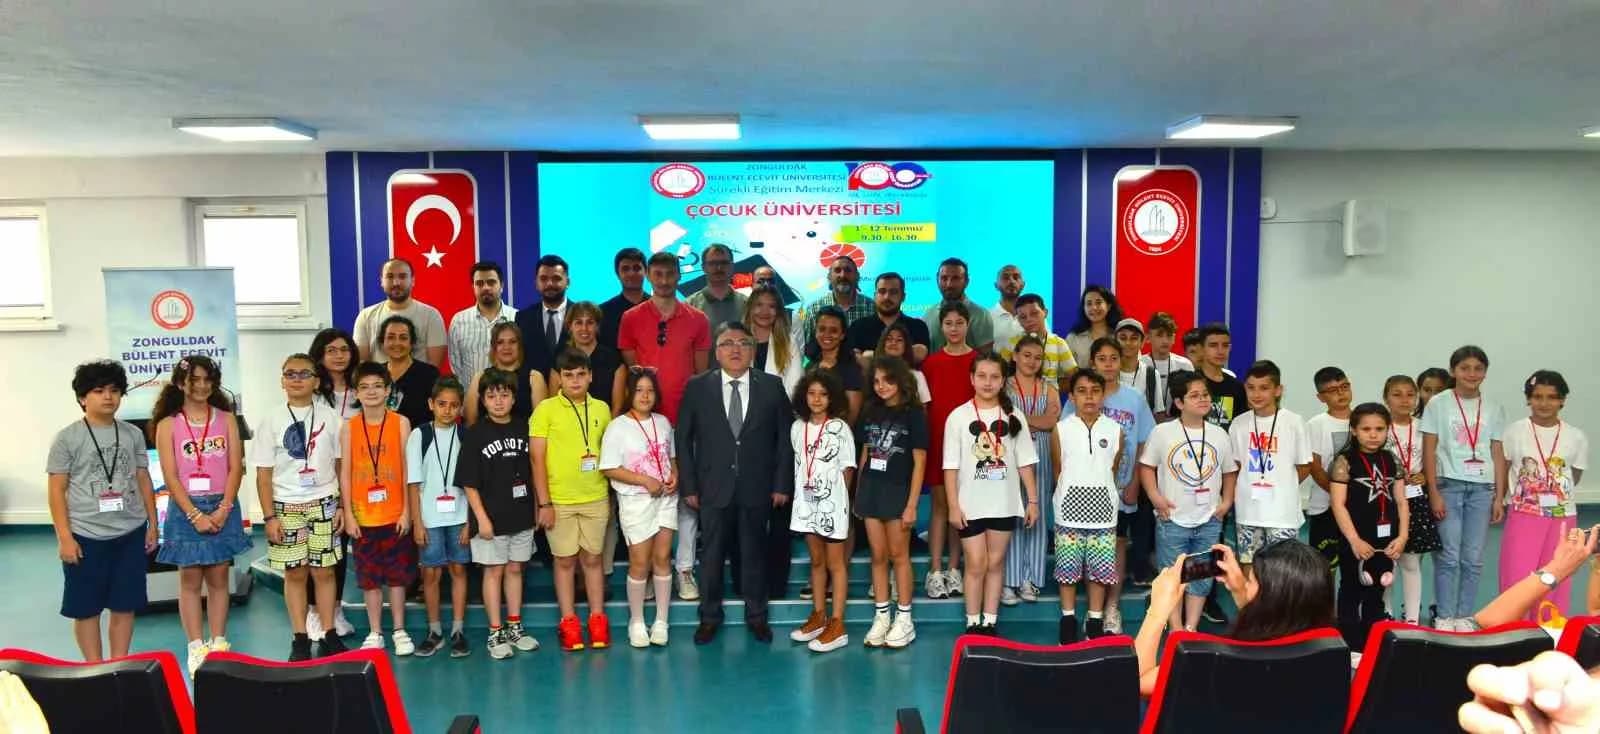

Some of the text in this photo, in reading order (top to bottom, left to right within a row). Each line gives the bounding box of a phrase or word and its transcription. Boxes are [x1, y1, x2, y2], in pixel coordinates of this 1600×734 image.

[709, 184, 844, 195] Sürekli Eğitim Merkezi
[685, 201, 901, 219] ÇOCUK ÜNİVERSİTESİ
[132, 335, 216, 347] ZONGULDAK
[122, 351, 176, 361] BÜLENT
[481, 439, 503, 459] YOU
